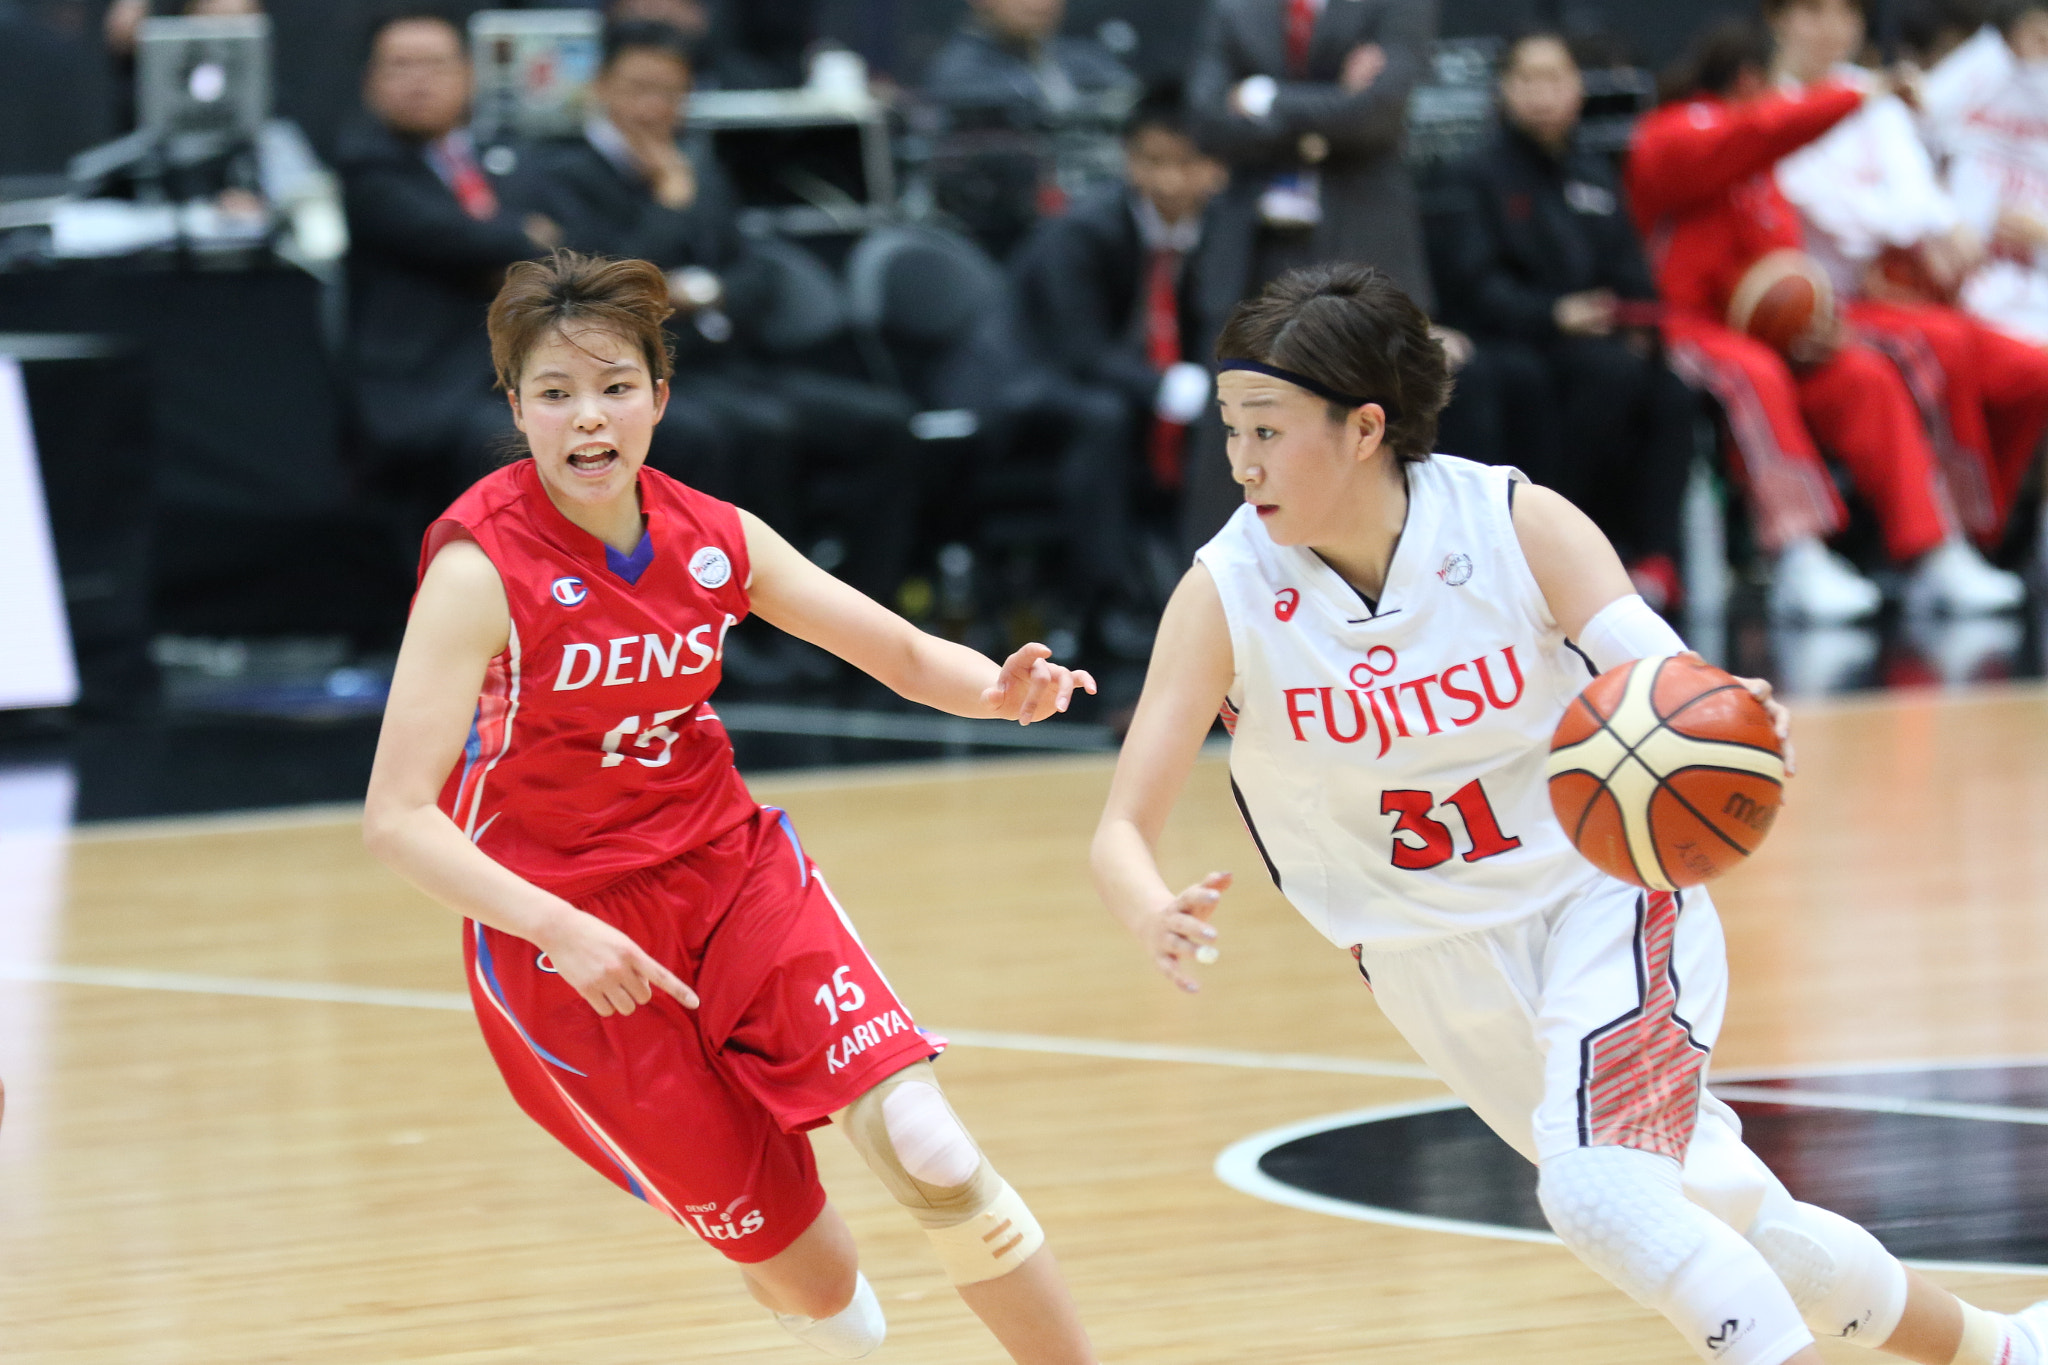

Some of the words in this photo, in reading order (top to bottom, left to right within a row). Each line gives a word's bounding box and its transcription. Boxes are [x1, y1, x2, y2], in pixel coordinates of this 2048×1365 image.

[1282, 644, 1526, 761] FUJITSU
[601, 703, 695, 768] 15
[1380, 777, 1523, 871] 31
[814, 964, 866, 1026] 15
[825, 1009, 910, 1075] KARIYA
[684, 1201, 717, 1213] DENSO
[690, 1209, 765, 1240] Iris
